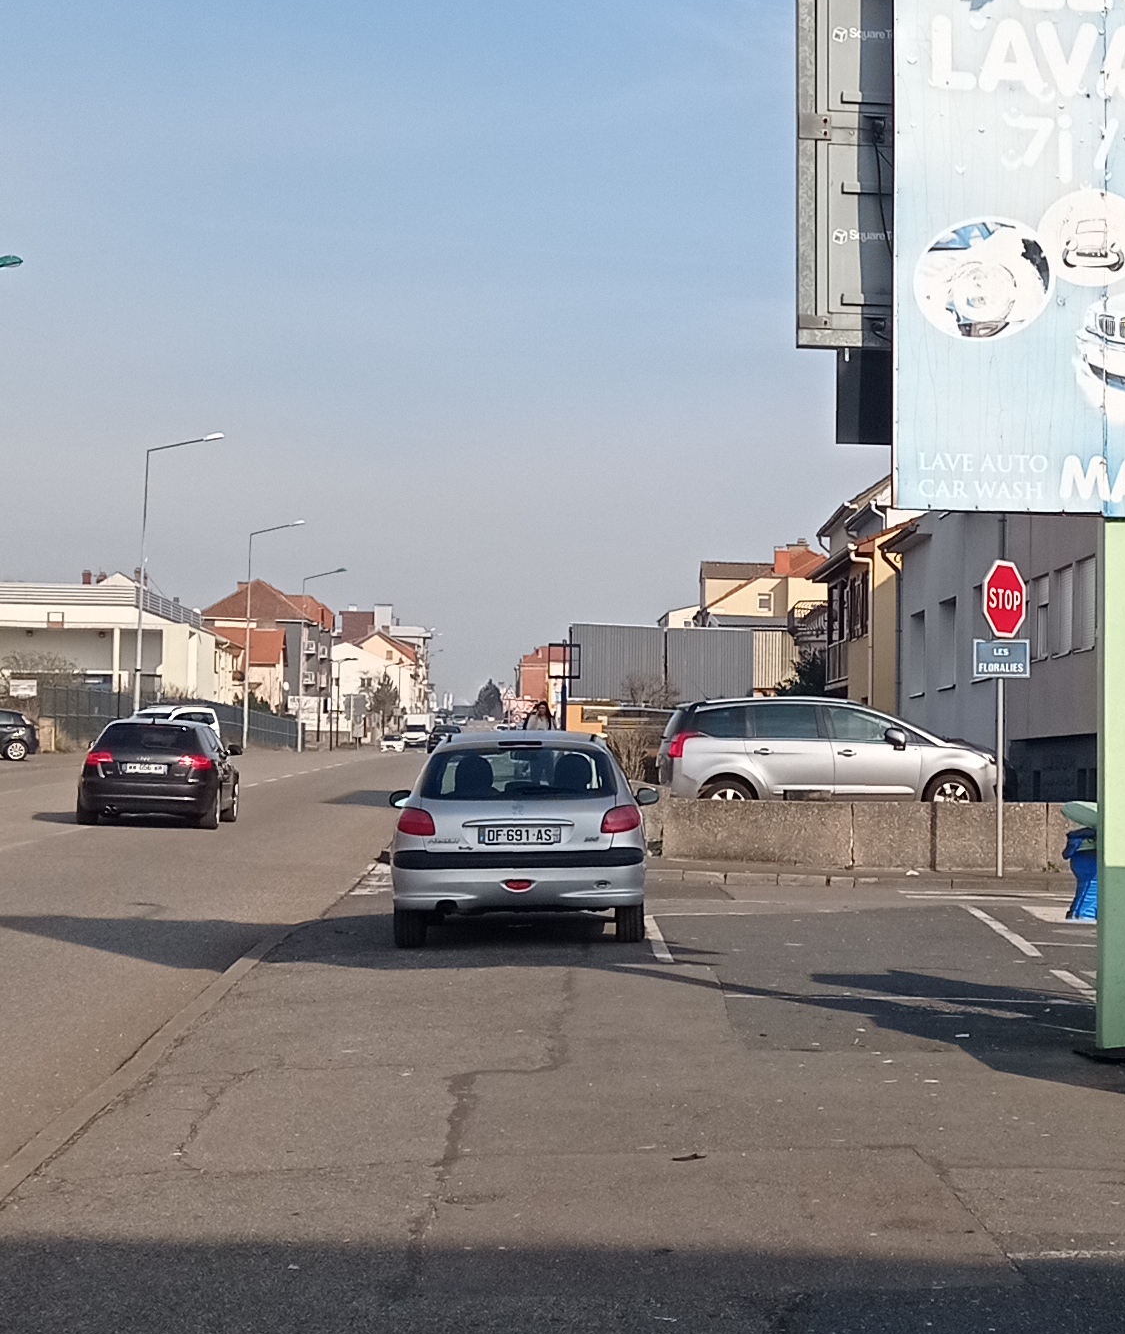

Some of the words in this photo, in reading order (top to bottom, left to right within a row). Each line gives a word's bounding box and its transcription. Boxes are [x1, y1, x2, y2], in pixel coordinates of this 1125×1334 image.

[849, 27, 893, 41] SquareT
[918, 451, 974, 473] LAVE
[980, 453, 1048, 474] AUTO
[917, 479, 969, 499] CAR
[973, 481, 1045, 500] WASH
[988, 587, 1021, 612] STOP
[993, 648, 1010, 656] LES
[978, 662, 1024, 673] FLORALIES
